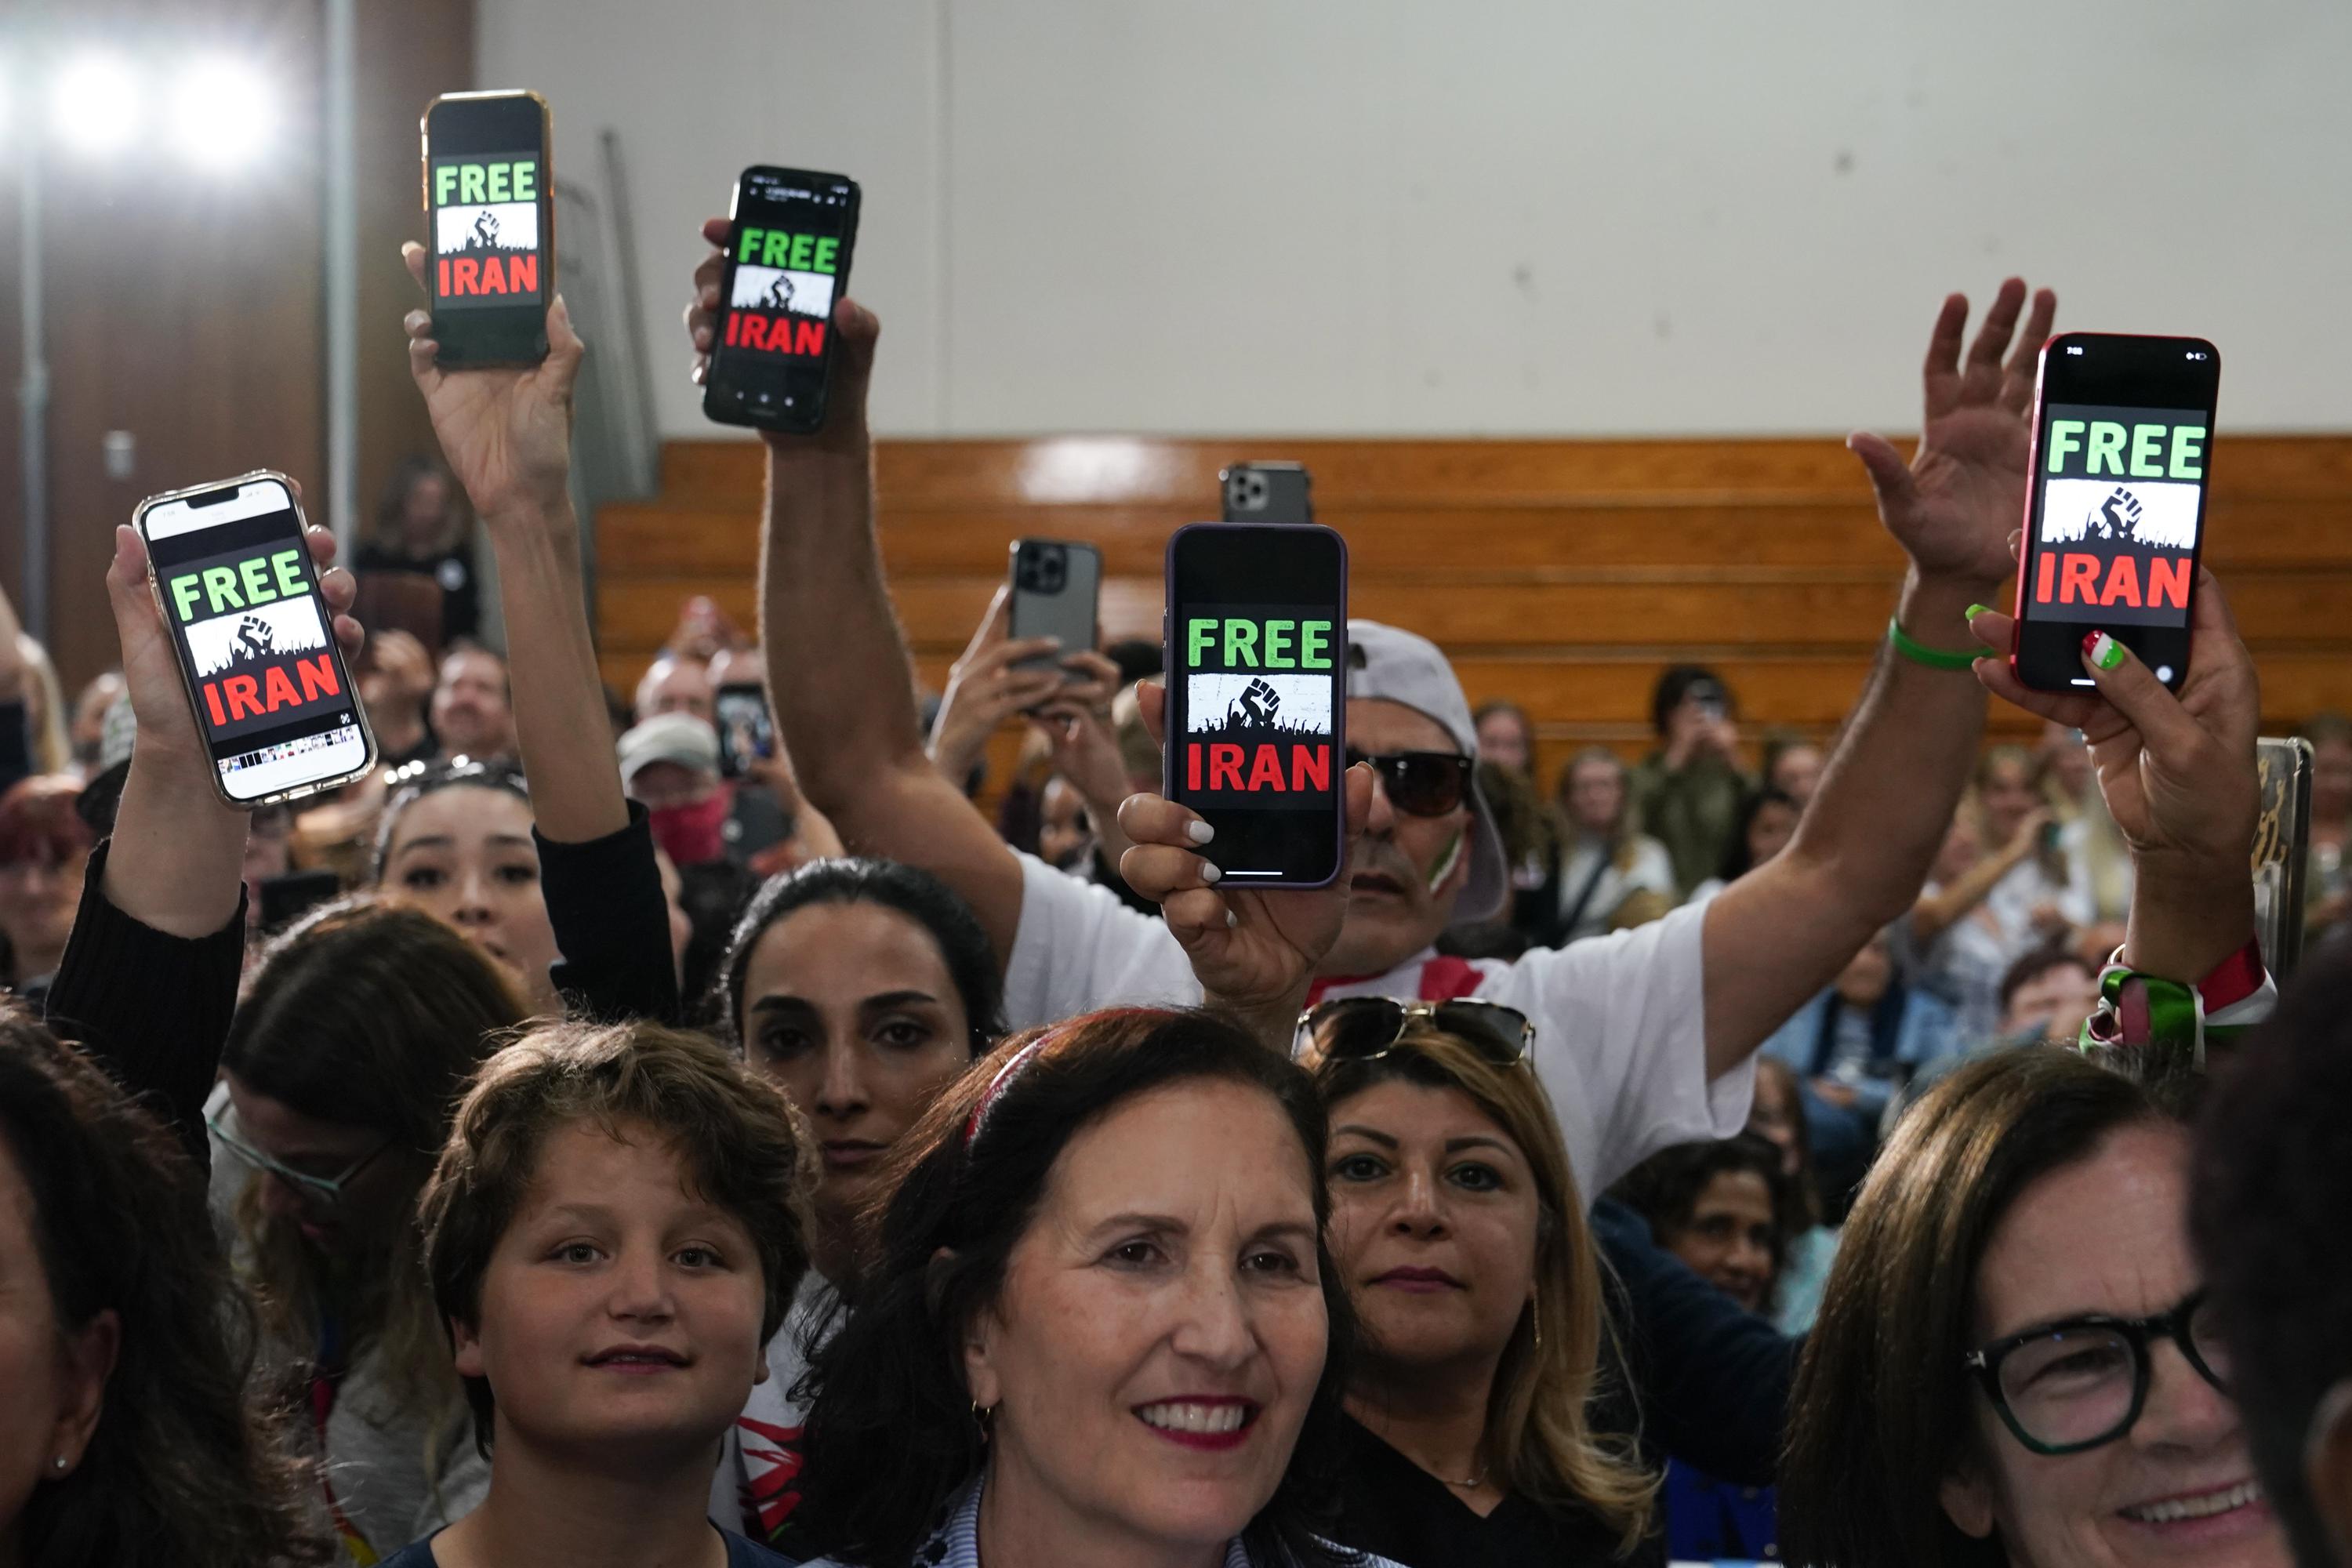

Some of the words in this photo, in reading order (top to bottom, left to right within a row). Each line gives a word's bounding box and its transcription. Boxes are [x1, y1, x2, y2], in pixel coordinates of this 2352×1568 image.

[436, 162, 536, 205] FREE
[738, 227, 840, 274] FREE
[439, 255, 538, 296] IRAN
[726, 312, 825, 358] IRAN
[2047, 419, 2206, 479] FREE
[170, 549, 310, 622] FREE
[2036, 551, 2192, 608] IRAN
[1188, 619, 1332, 668] FREE
[203, 653, 340, 727] IRAN
[1187, 743, 1330, 792] IRAN
